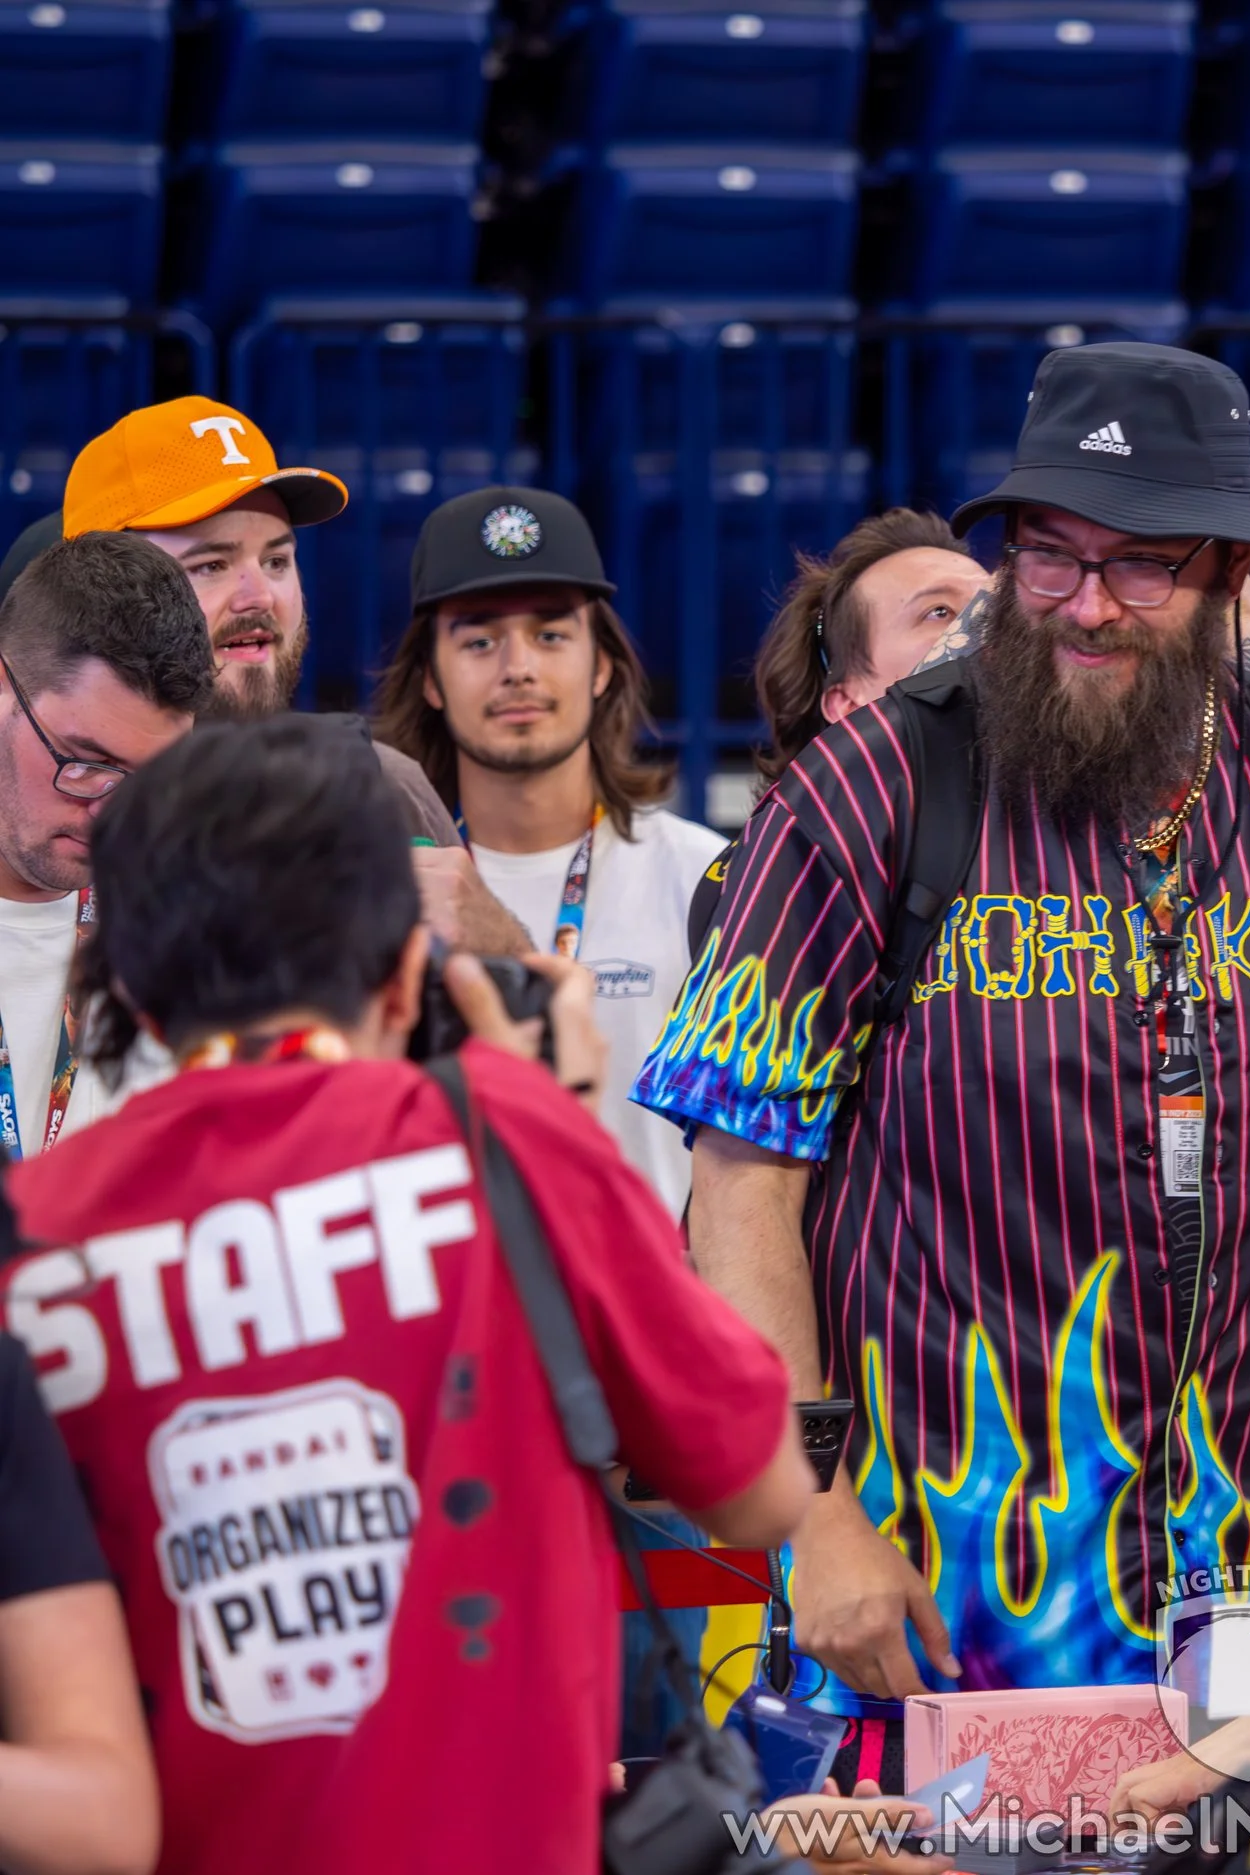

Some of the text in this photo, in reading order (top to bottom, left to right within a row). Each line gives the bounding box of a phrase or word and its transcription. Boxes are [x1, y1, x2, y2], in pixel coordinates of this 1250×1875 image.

[190, 416, 250, 465] T
[1079, 439, 1132, 455] adidas
[6, 1143, 477, 1414] STAFF
[169, 1485, 414, 1592] ORGANIZED
[213, 1559, 387, 1657] PLAY
